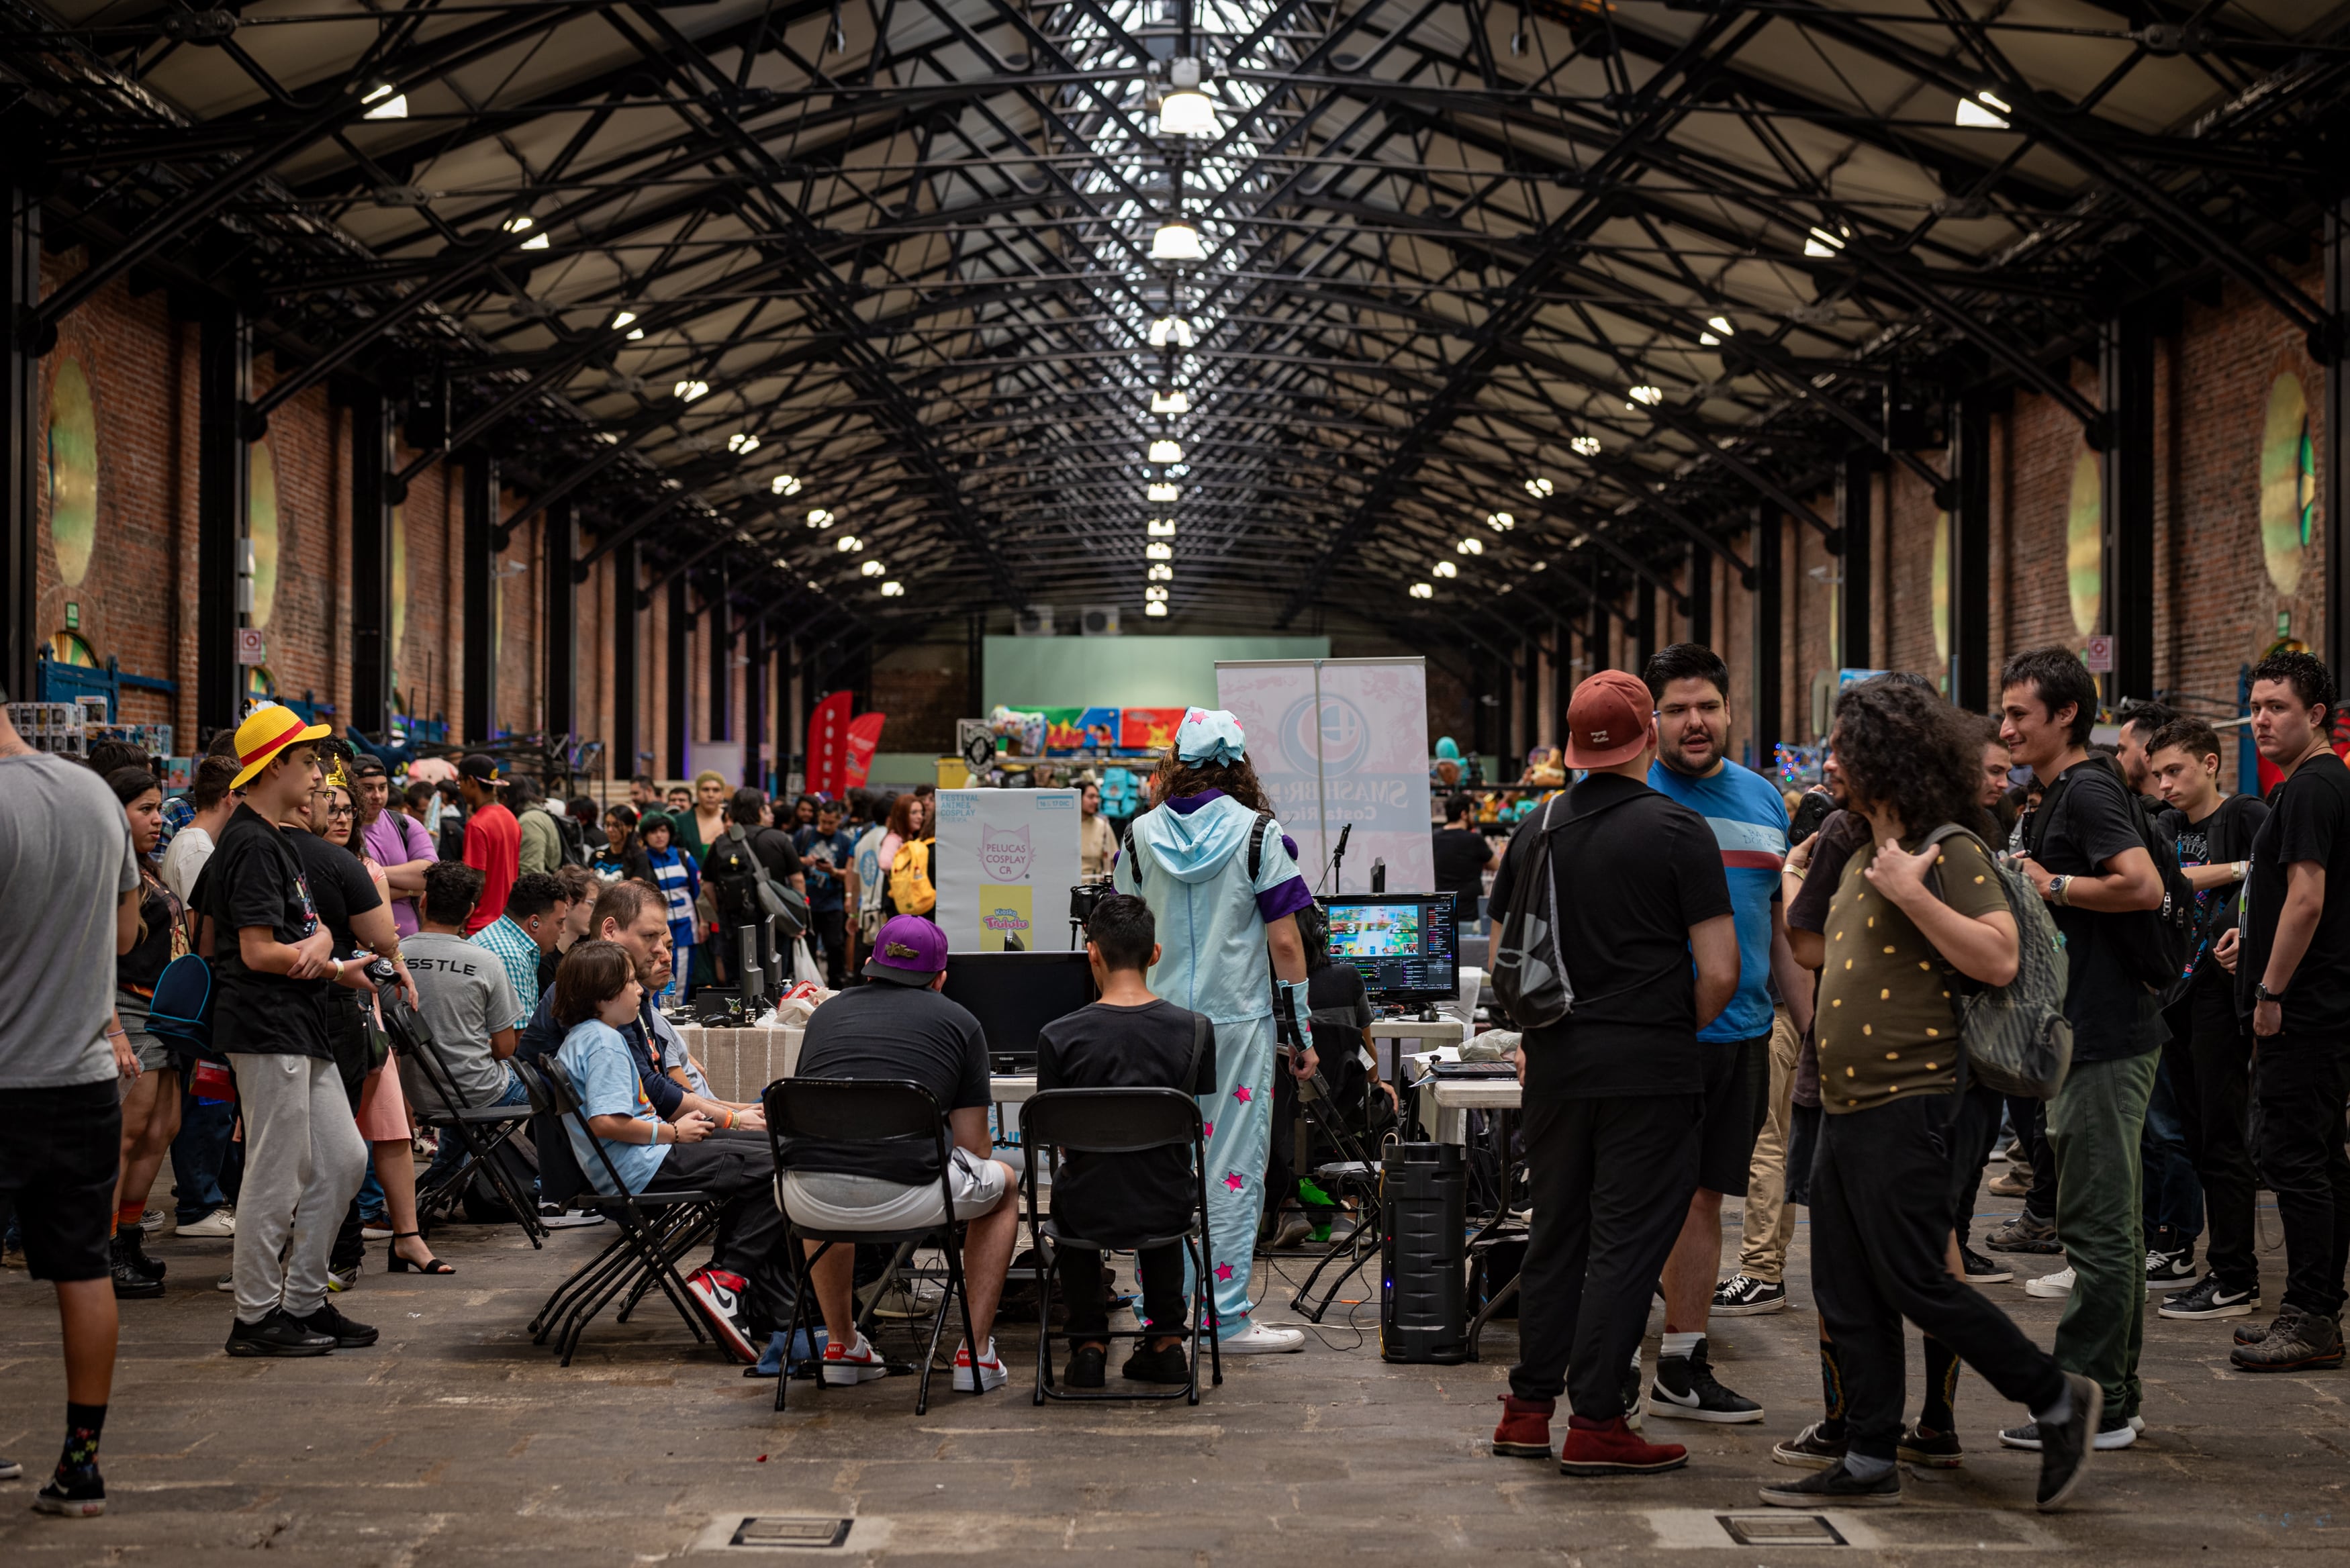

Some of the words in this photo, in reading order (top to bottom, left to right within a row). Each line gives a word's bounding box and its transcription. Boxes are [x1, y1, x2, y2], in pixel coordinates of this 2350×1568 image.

[986, 844, 1026, 852] PELUCAS
[986, 854, 1027, 864] COSPLAY
[999, 866, 1012, 874] CR
[984, 916, 1029, 930] Trululu
[1347, 922, 1356, 934] 3
[1392, 922, 1401, 934] 2
